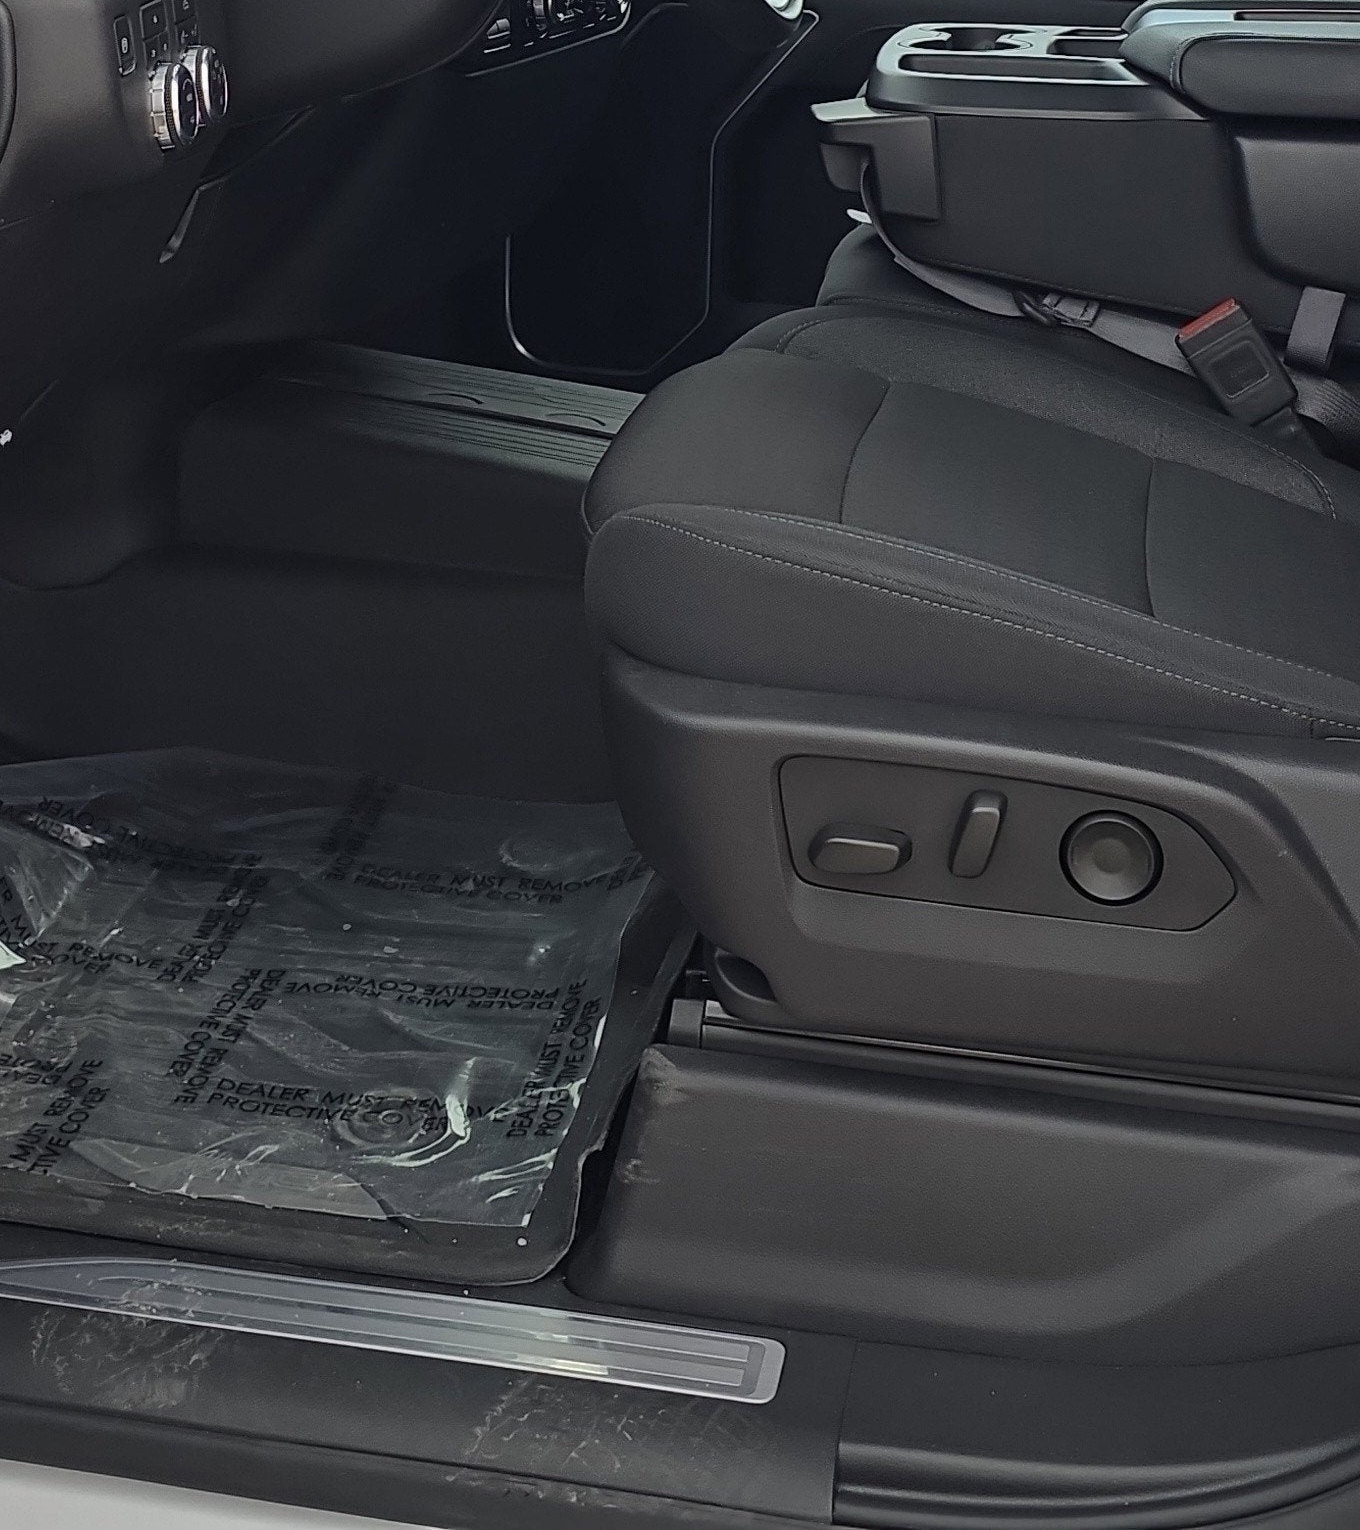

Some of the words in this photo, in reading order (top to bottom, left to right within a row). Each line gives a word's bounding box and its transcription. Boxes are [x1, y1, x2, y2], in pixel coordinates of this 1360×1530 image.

[450, 873, 507, 889] MUST
[487, 890, 564, 904] COVER
[397, 993, 456, 1008] MUST
[424, 982, 561, 1001] PROTECTIVE
[465, 999, 554, 1011] DEALER
[216, 1078, 310, 1103] DEALER
[321, 1090, 385, 1107] MUST
[9, 1122, 52, 1163] MUST
[43, 1060, 104, 1117] REMOVE
[60, 1087, 111, 1134] COVER
[207, 1091, 359, 1122] PROTECTIVE
